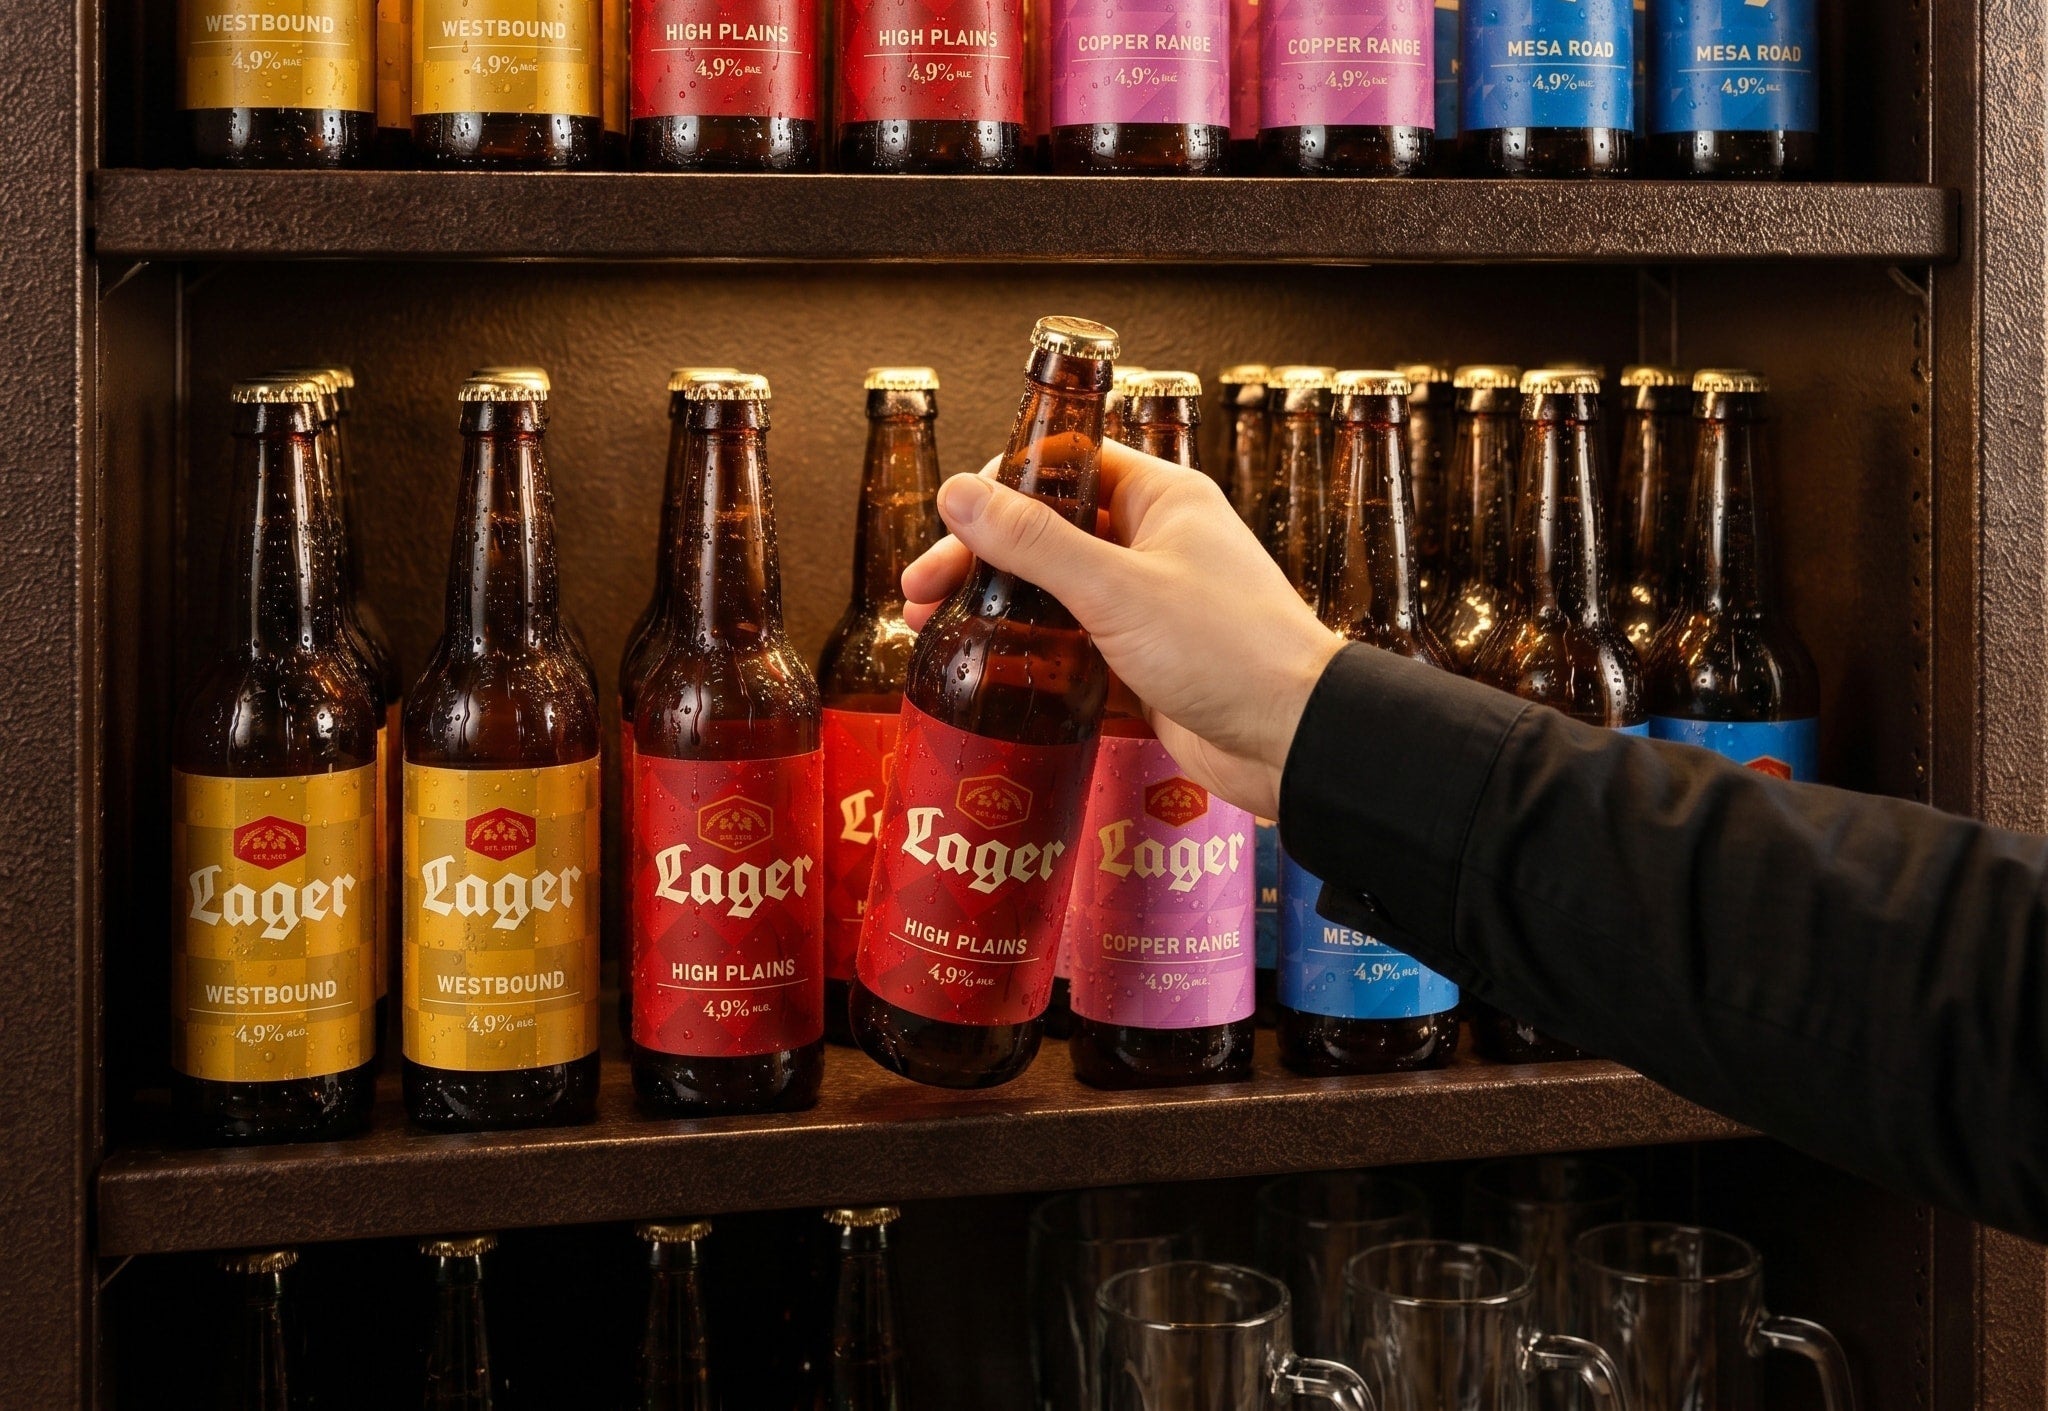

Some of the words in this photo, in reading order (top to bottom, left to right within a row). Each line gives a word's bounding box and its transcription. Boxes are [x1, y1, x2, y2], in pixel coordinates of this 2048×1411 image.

[206, 14, 334, 34] WESTBOUND
[442, 19, 566, 39] WESTBOUND
[666, 24, 712, 41] HIGH
[719, 23, 789, 42] PLAINS
[879, 29, 924, 46] HIGH
[930, 29, 998, 47] PLAINS
[1078, 34, 1149, 52] COPPER
[1288, 37, 1361, 55] COPPER
[1367, 37, 1421, 56] RANGE
[1508, 40, 1562, 57] MESA
[1569, 41, 1614, 58] ROAD
[231, 50, 281, 73] 4,9%
[1696, 45, 1751, 62] MESA
[1757, 46, 1801, 62] ROAD
[471, 55, 518, 77] 4,9%
[695, 57, 743, 80] 4,9%
[901, 807, 1066, 894] Lager
[1098, 818, 1245, 893] Lager
[422, 854, 582, 931] Lager
[655, 843, 814, 919] Lager
[189, 864, 357, 940] Lager
[904, 917, 950, 947] HIGH
[956, 934, 1027, 955] PLAINS
[1102, 933, 1180, 955] COPPER
[1185, 931, 1240, 954] RANGE
[672, 962, 718, 982] HIGH
[726, 958, 796, 982] PLAINS
[205, 980, 337, 1005] WESTBOUND
[437, 970, 565, 995] WESTBOUND
[702, 999, 750, 1022] 4,9%
[467, 1014, 515, 1036] 4,9%
